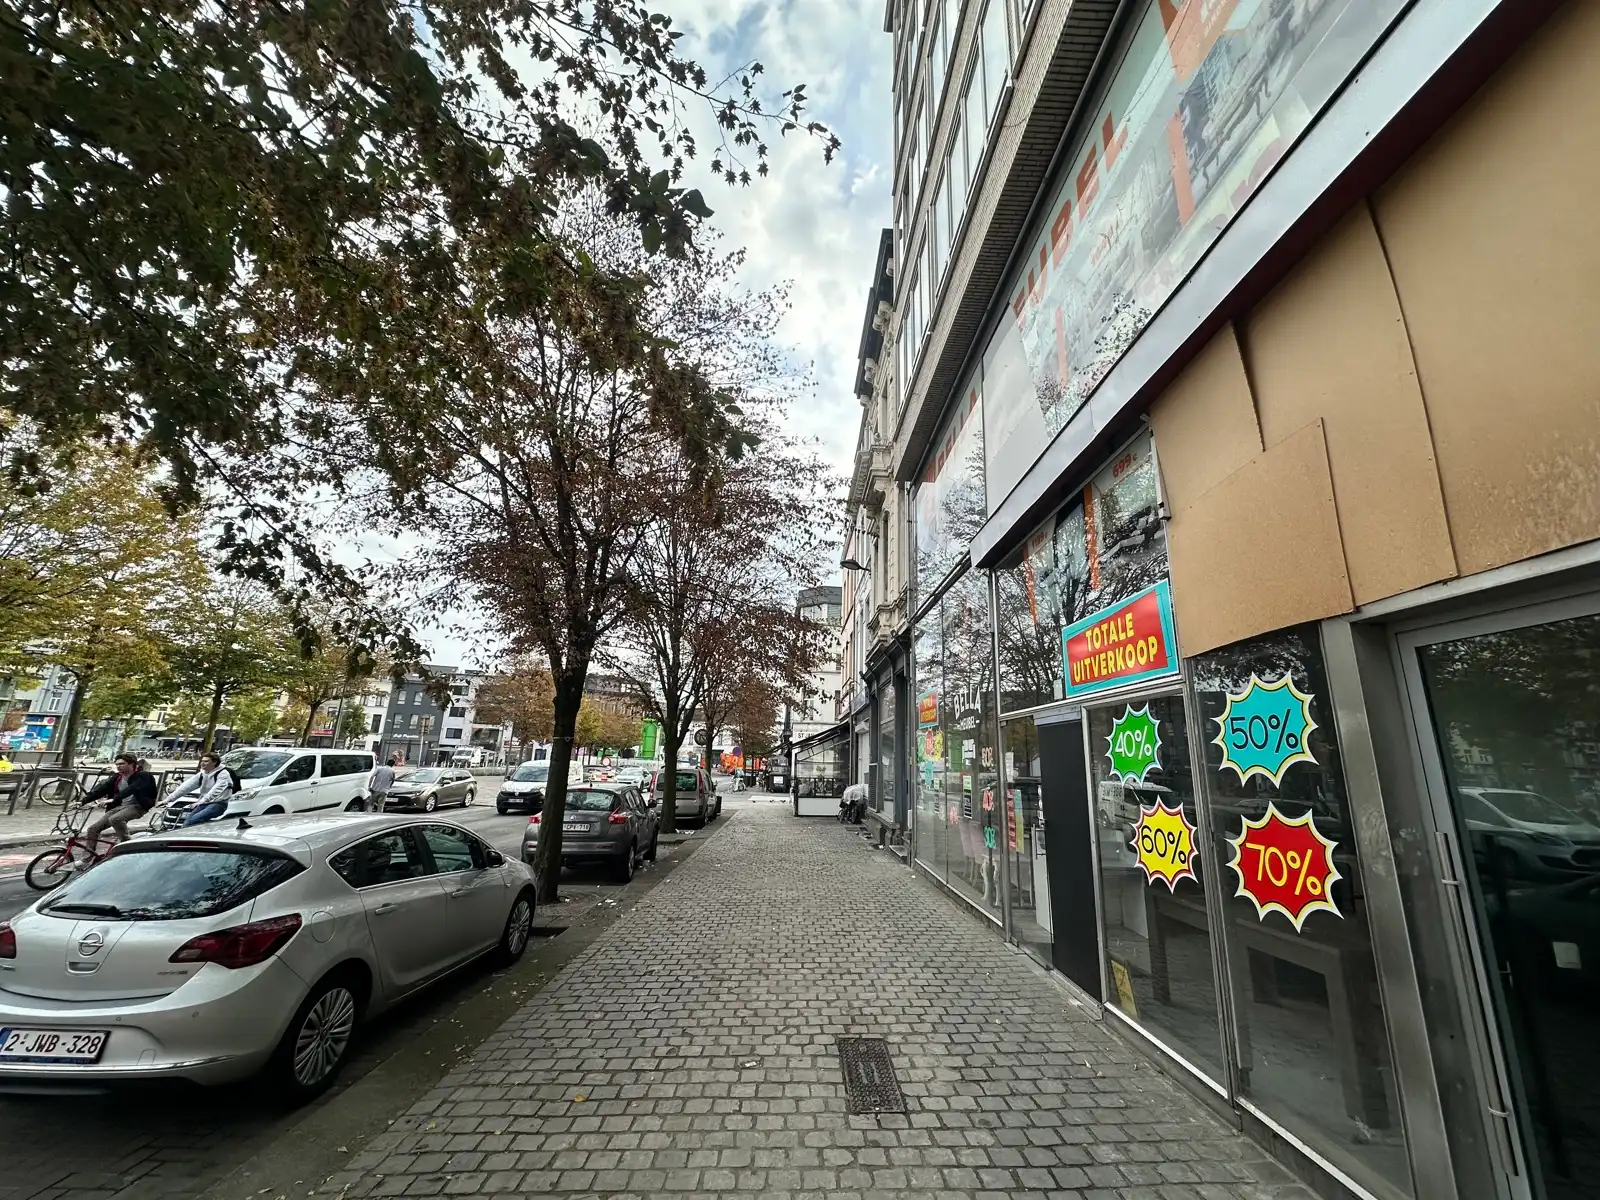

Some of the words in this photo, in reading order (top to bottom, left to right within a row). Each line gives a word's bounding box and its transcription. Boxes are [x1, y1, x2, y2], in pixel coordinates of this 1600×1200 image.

[1085, 612, 1135, 651] TOTALE
[1073, 635, 1158, 683] UITVERKOOP
[954, 686, 981, 720] BELLA
[1115, 725, 1151, 760] 40%
[1230, 708, 1299, 753] 50%
[1141, 825, 1187, 864] 60%
[1246, 843, 1322, 896] 70%
[4, 1033, 102, 1055] 2-JWB-328
